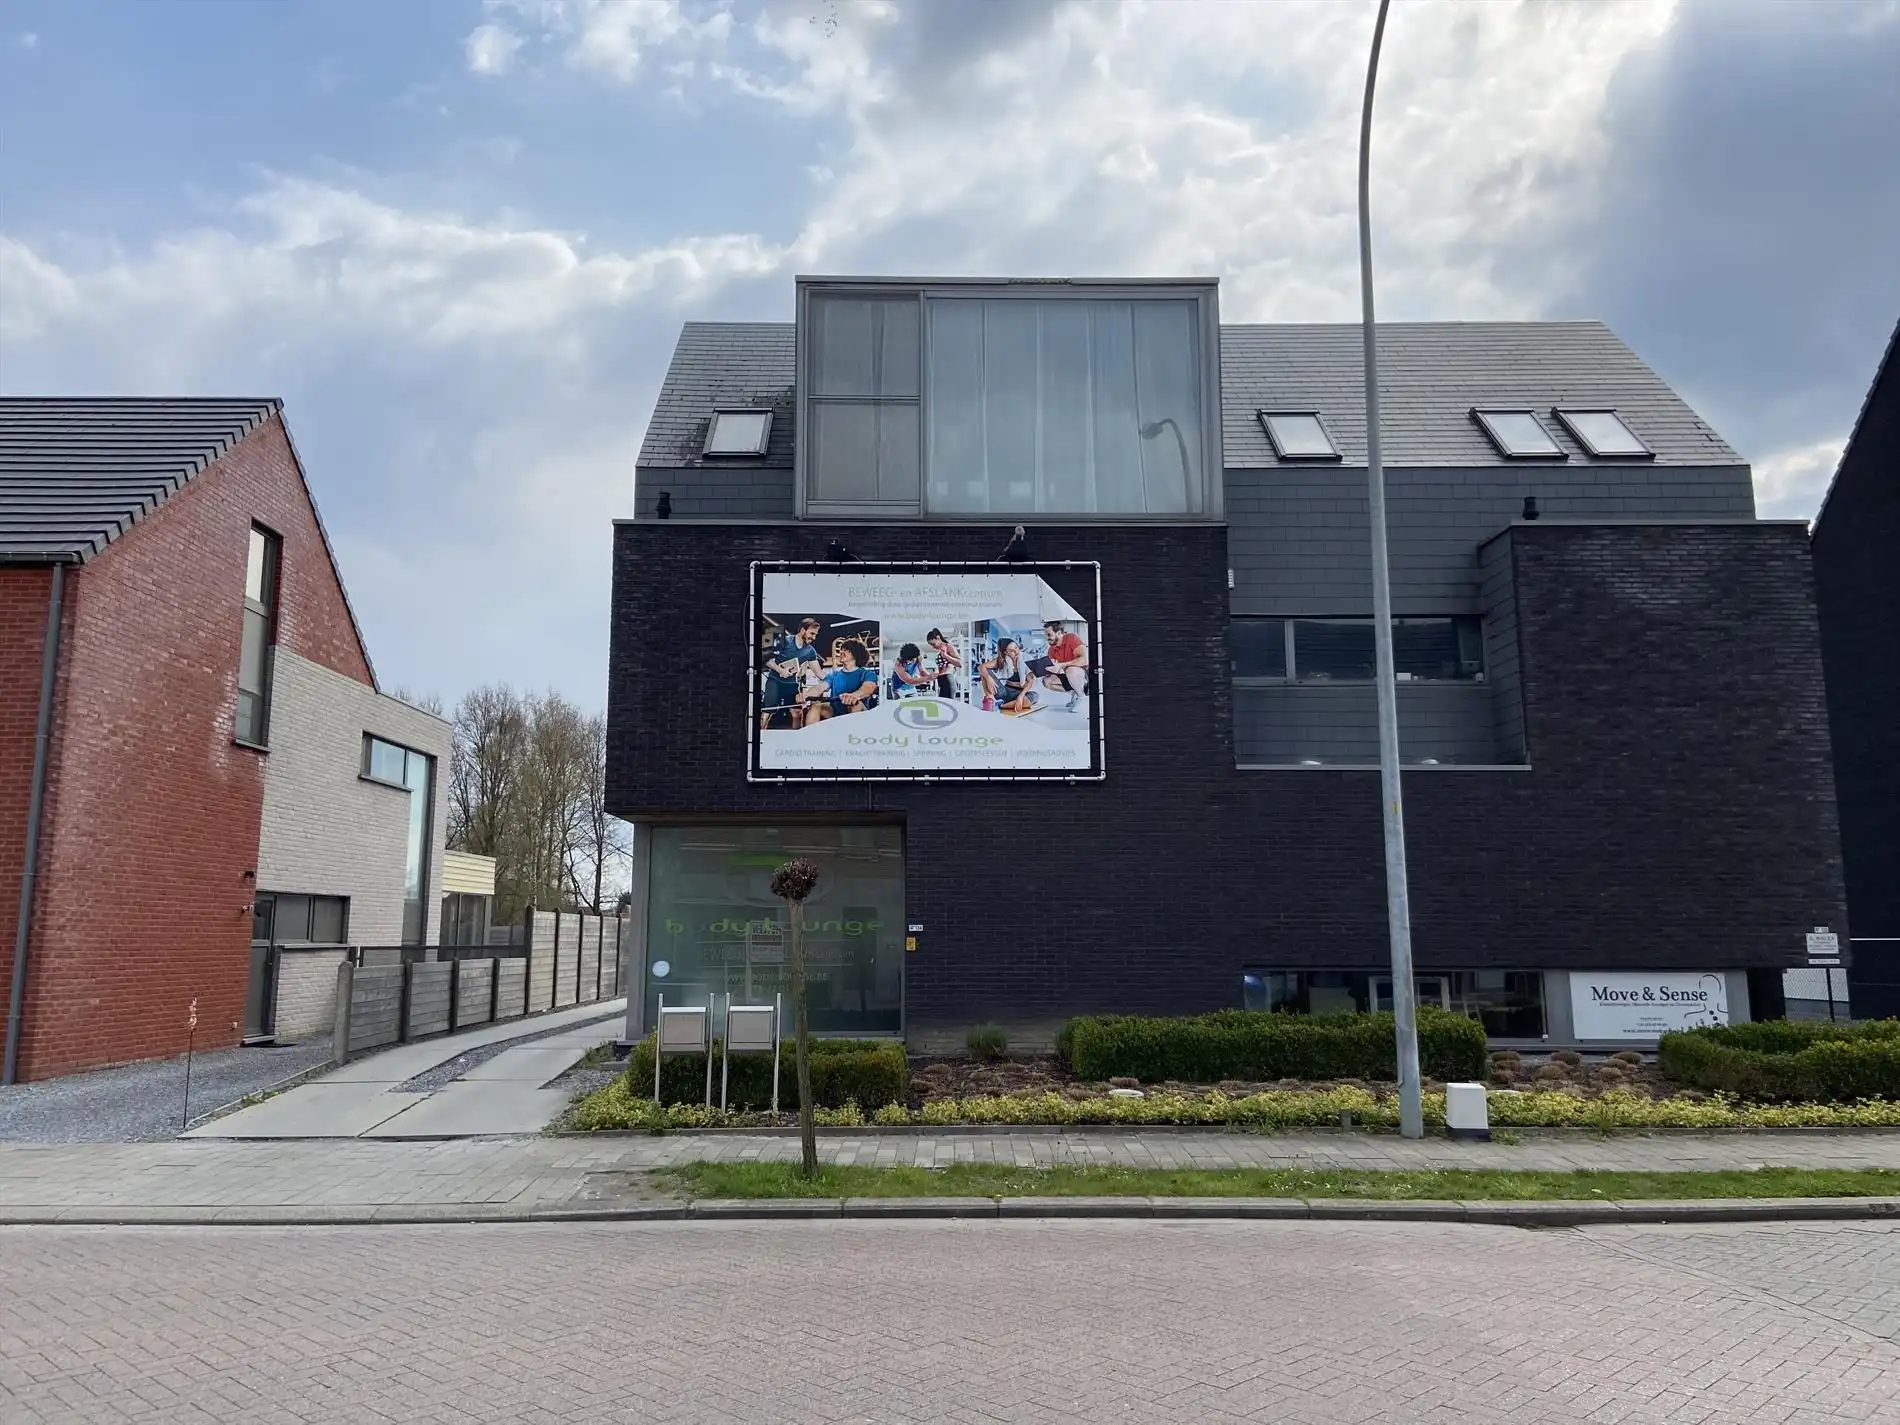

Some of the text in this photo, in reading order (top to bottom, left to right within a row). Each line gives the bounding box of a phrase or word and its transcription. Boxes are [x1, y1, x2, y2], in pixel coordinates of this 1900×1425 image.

[848, 734, 909, 747] body
[1591, 986, 1708, 1001] Move & Sense
